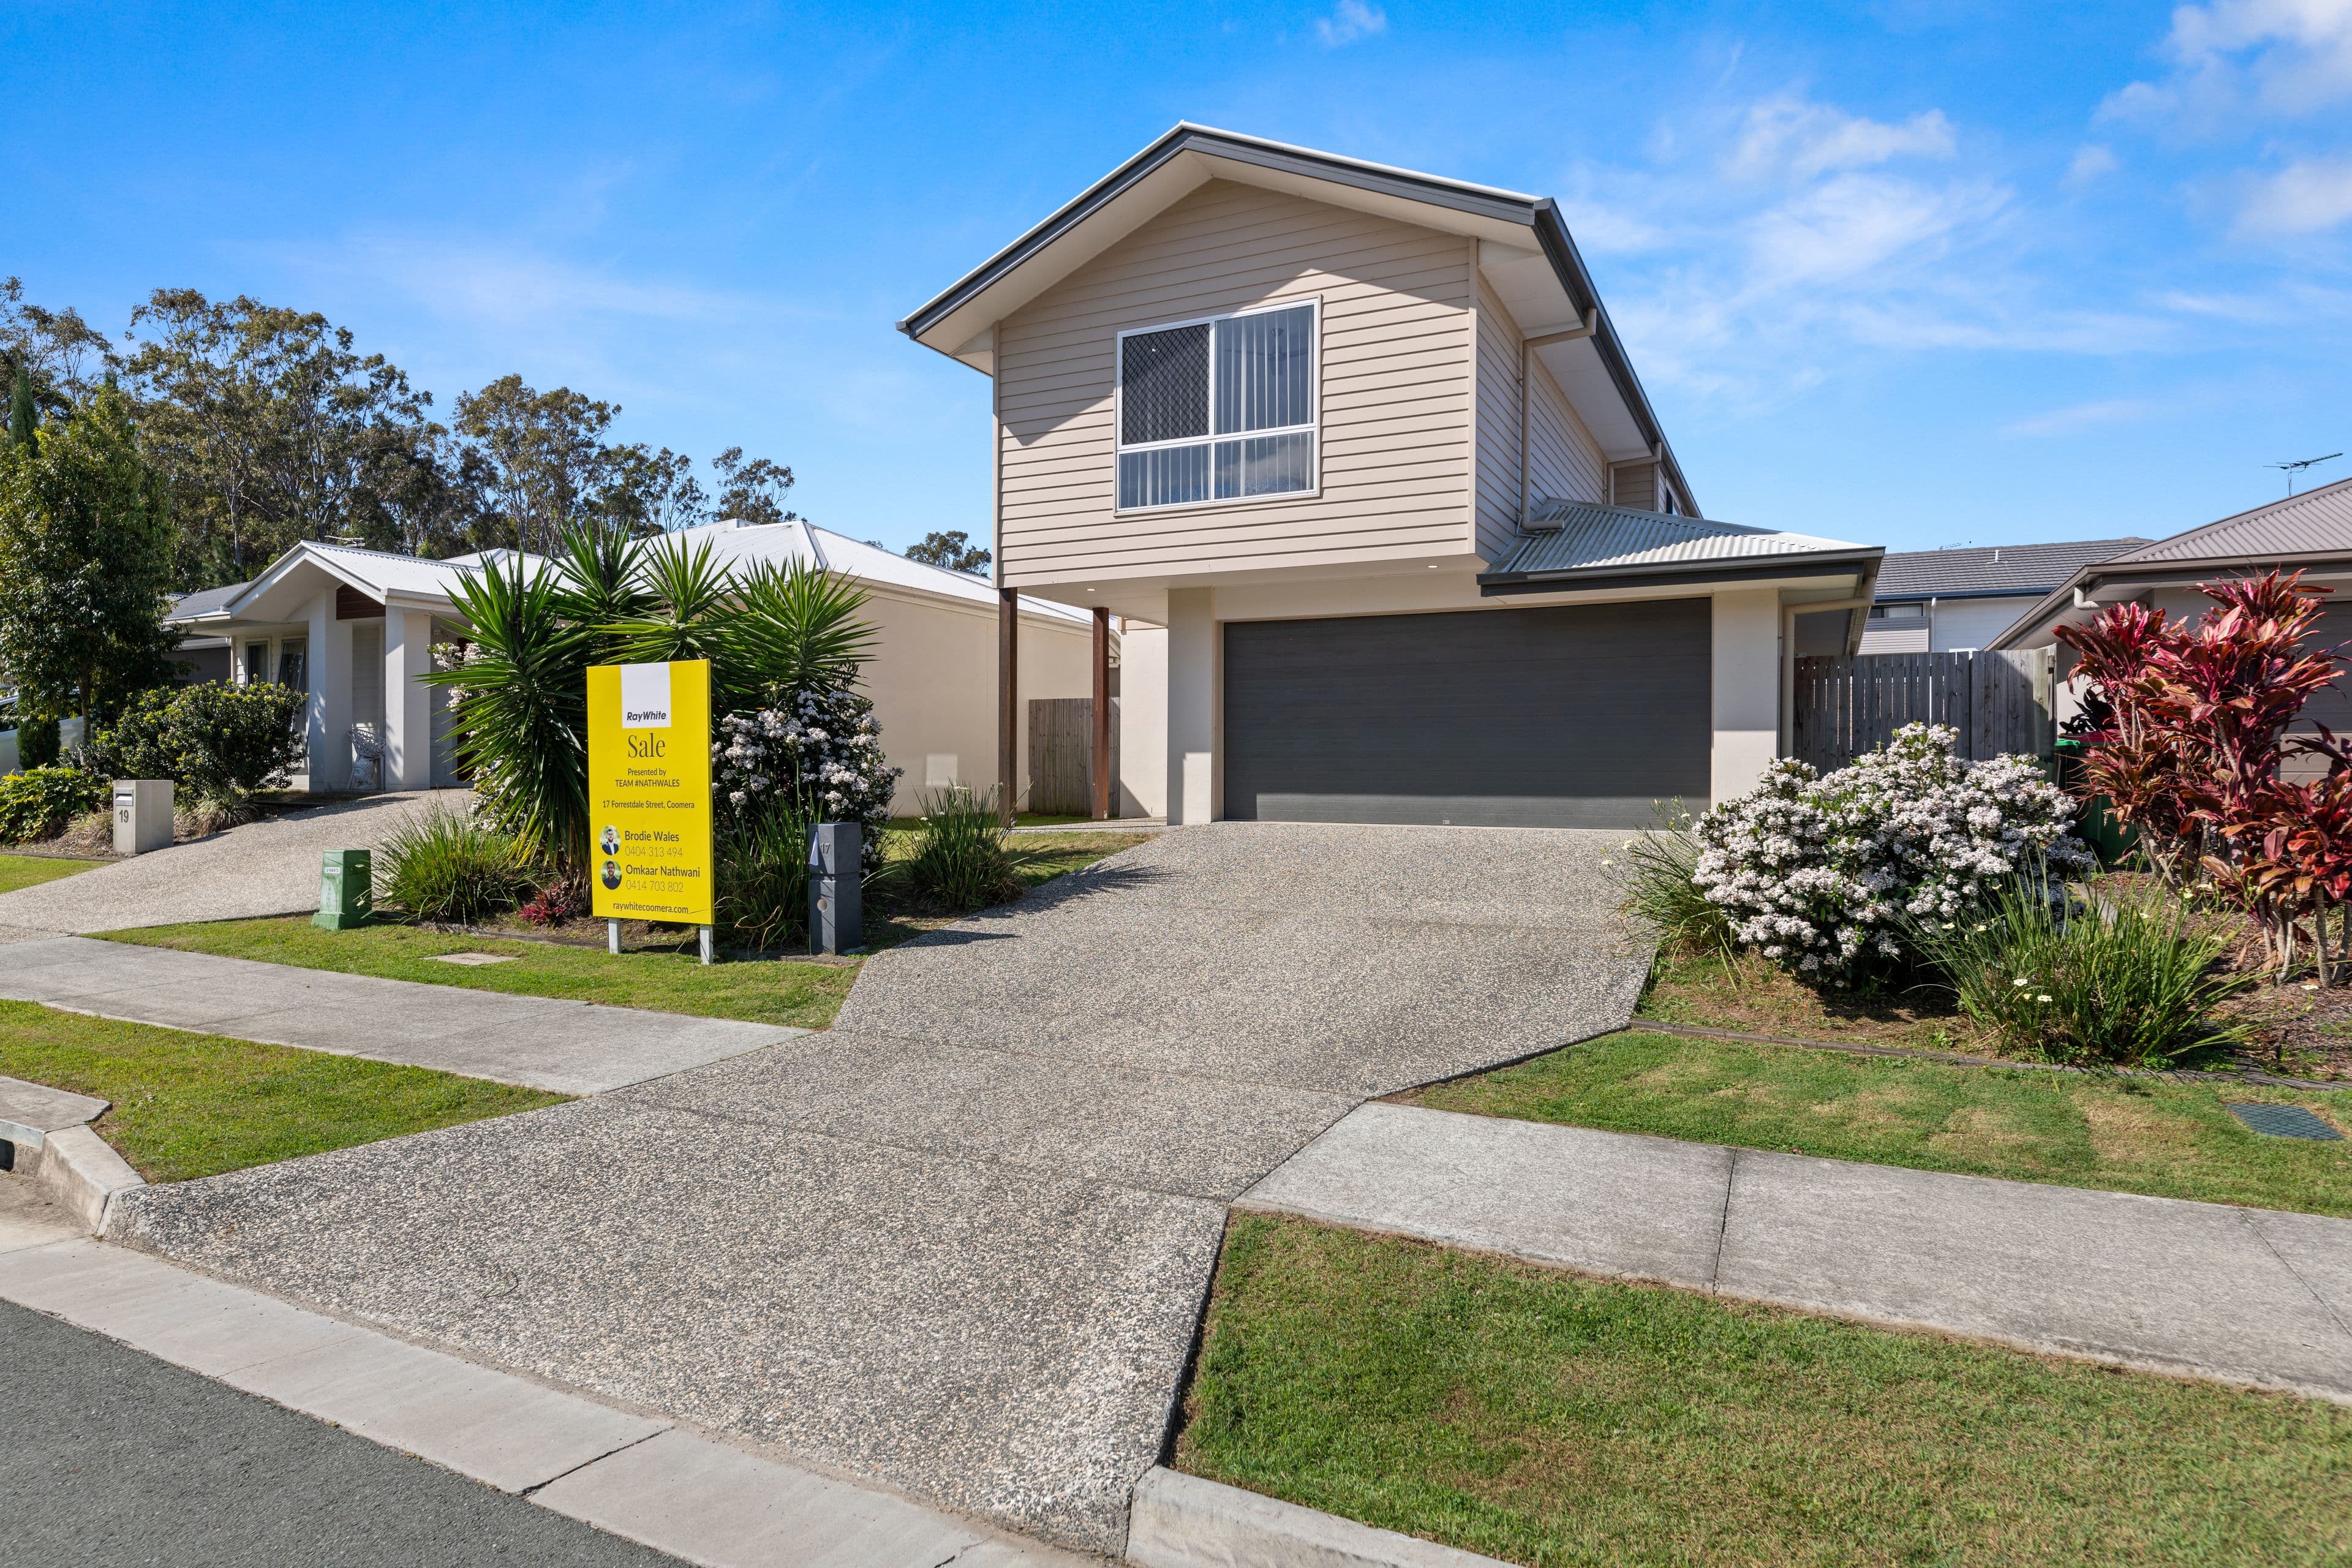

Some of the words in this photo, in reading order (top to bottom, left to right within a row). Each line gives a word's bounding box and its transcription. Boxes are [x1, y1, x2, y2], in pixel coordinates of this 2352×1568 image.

[628, 733, 666, 758] Sale
[659, 768, 666, 777] by
[646, 801, 666, 809] Street,
[119, 809, 129, 823] 19
[625, 831, 652, 841] Brodie
[654, 831, 679, 842] Wales
[625, 846, 646, 856] 0404
[649, 846, 665, 857] 313
[667, 847, 683, 858] 494
[820, 843, 831, 854] 17
[626, 864, 658, 876] Omkaar
[660, 865, 700, 878] Nathwani
[626, 880, 647, 891] 0414
[649, 881, 665, 892] 703
[668, 882, 684, 892] 802
[613, 902, 688, 914] raywhitecoomera.com
